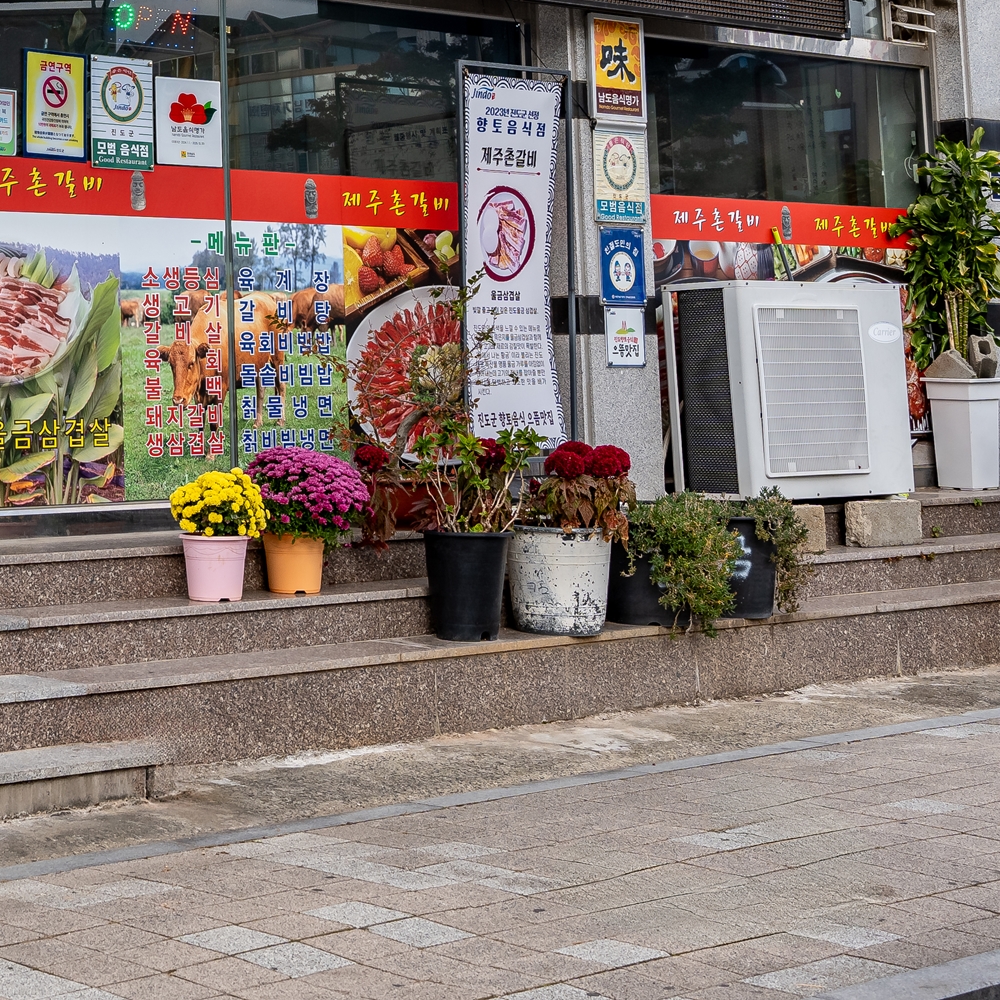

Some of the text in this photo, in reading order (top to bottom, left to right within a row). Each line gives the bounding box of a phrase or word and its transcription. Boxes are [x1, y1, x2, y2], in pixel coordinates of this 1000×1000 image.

[114, 3, 192, 36] OPEN
[39, 60, 72, 74] 금연구역
[599, 37, 636, 83] 味
[470, 87, 492, 100] Jindo
[597, 92, 640, 107] 남도음식명가
[485, 106, 540, 121] 2023년 진도군 선정
[110, 128, 135, 138] 진도군
[170, 125, 206, 135] 남도음식명가
[476, 116, 547, 138] 향토음식점
[96, 141, 150, 159] 모범 음식점
[98, 156, 148, 166] Good Restaurant
[481, 146, 538, 168] 제주촌갈비
[341, 189, 450, 218] 제주촌갈비
[600, 200, 643, 215] 모범음식점
[672, 207, 760, 233] 제주촌갈비
[141, 266, 220, 291] 소생등심
[237, 266, 331, 294] 육계장
[142, 293, 221, 318] 생고기
[490, 289, 521, 301] 울금삼겹살
[238, 299, 331, 325] 갈비탕
[143, 321, 222, 345] 갈비살
[238, 331, 332, 356] 육회비빔밥
[873, 327, 897, 337] Carrier
[612, 343, 640, 358] 으뜸맛집
[240, 363, 333, 388] 돌솥비빔밥
[145, 403, 224, 429] 돼지갈비
[241, 395, 334, 420] 칡물냉면
[477, 409, 554, 428] 진도군 향토음식 으뜸맛집
[146, 431, 225, 457] 생삼겹살
[242, 428, 335, 454] 칡비빔냉면
